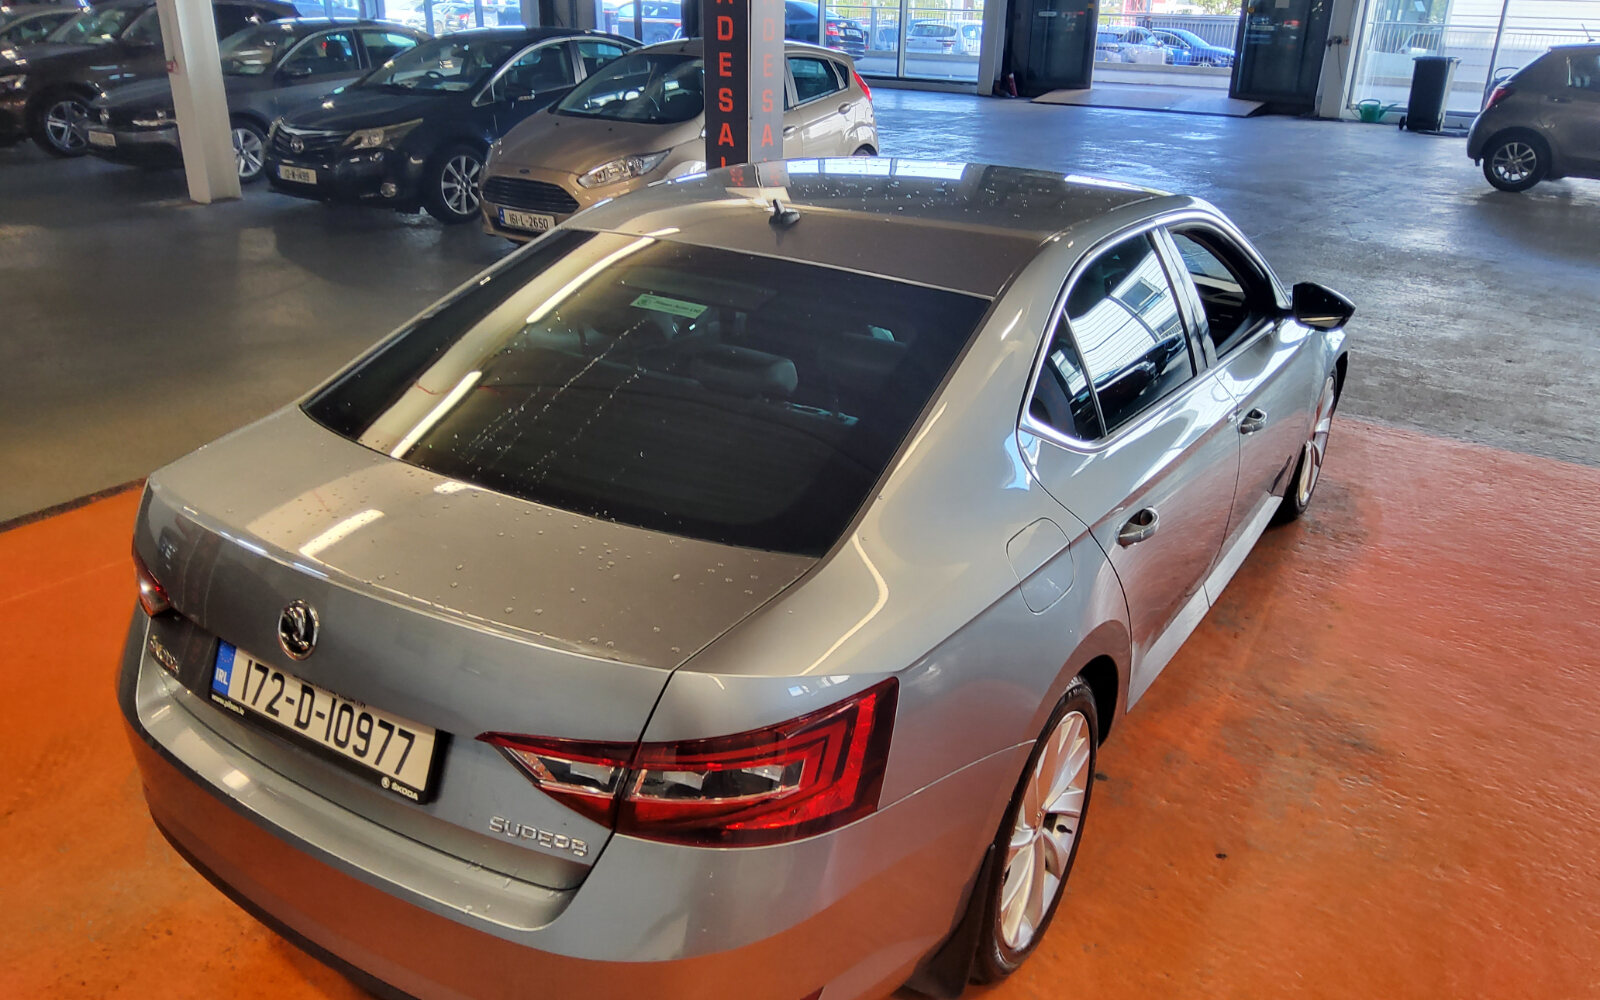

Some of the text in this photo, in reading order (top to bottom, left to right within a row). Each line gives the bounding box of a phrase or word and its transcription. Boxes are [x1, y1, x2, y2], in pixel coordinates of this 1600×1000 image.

[715, 0, 735, 168] DESA
[761, 0, 775, 162] DESA
[508, 211, 549, 230] 161-L-2650
[215, 666, 229, 686] IRL
[241, 659, 416, 776] 172-D-10977
[488, 815, 589, 857] SUPERB
